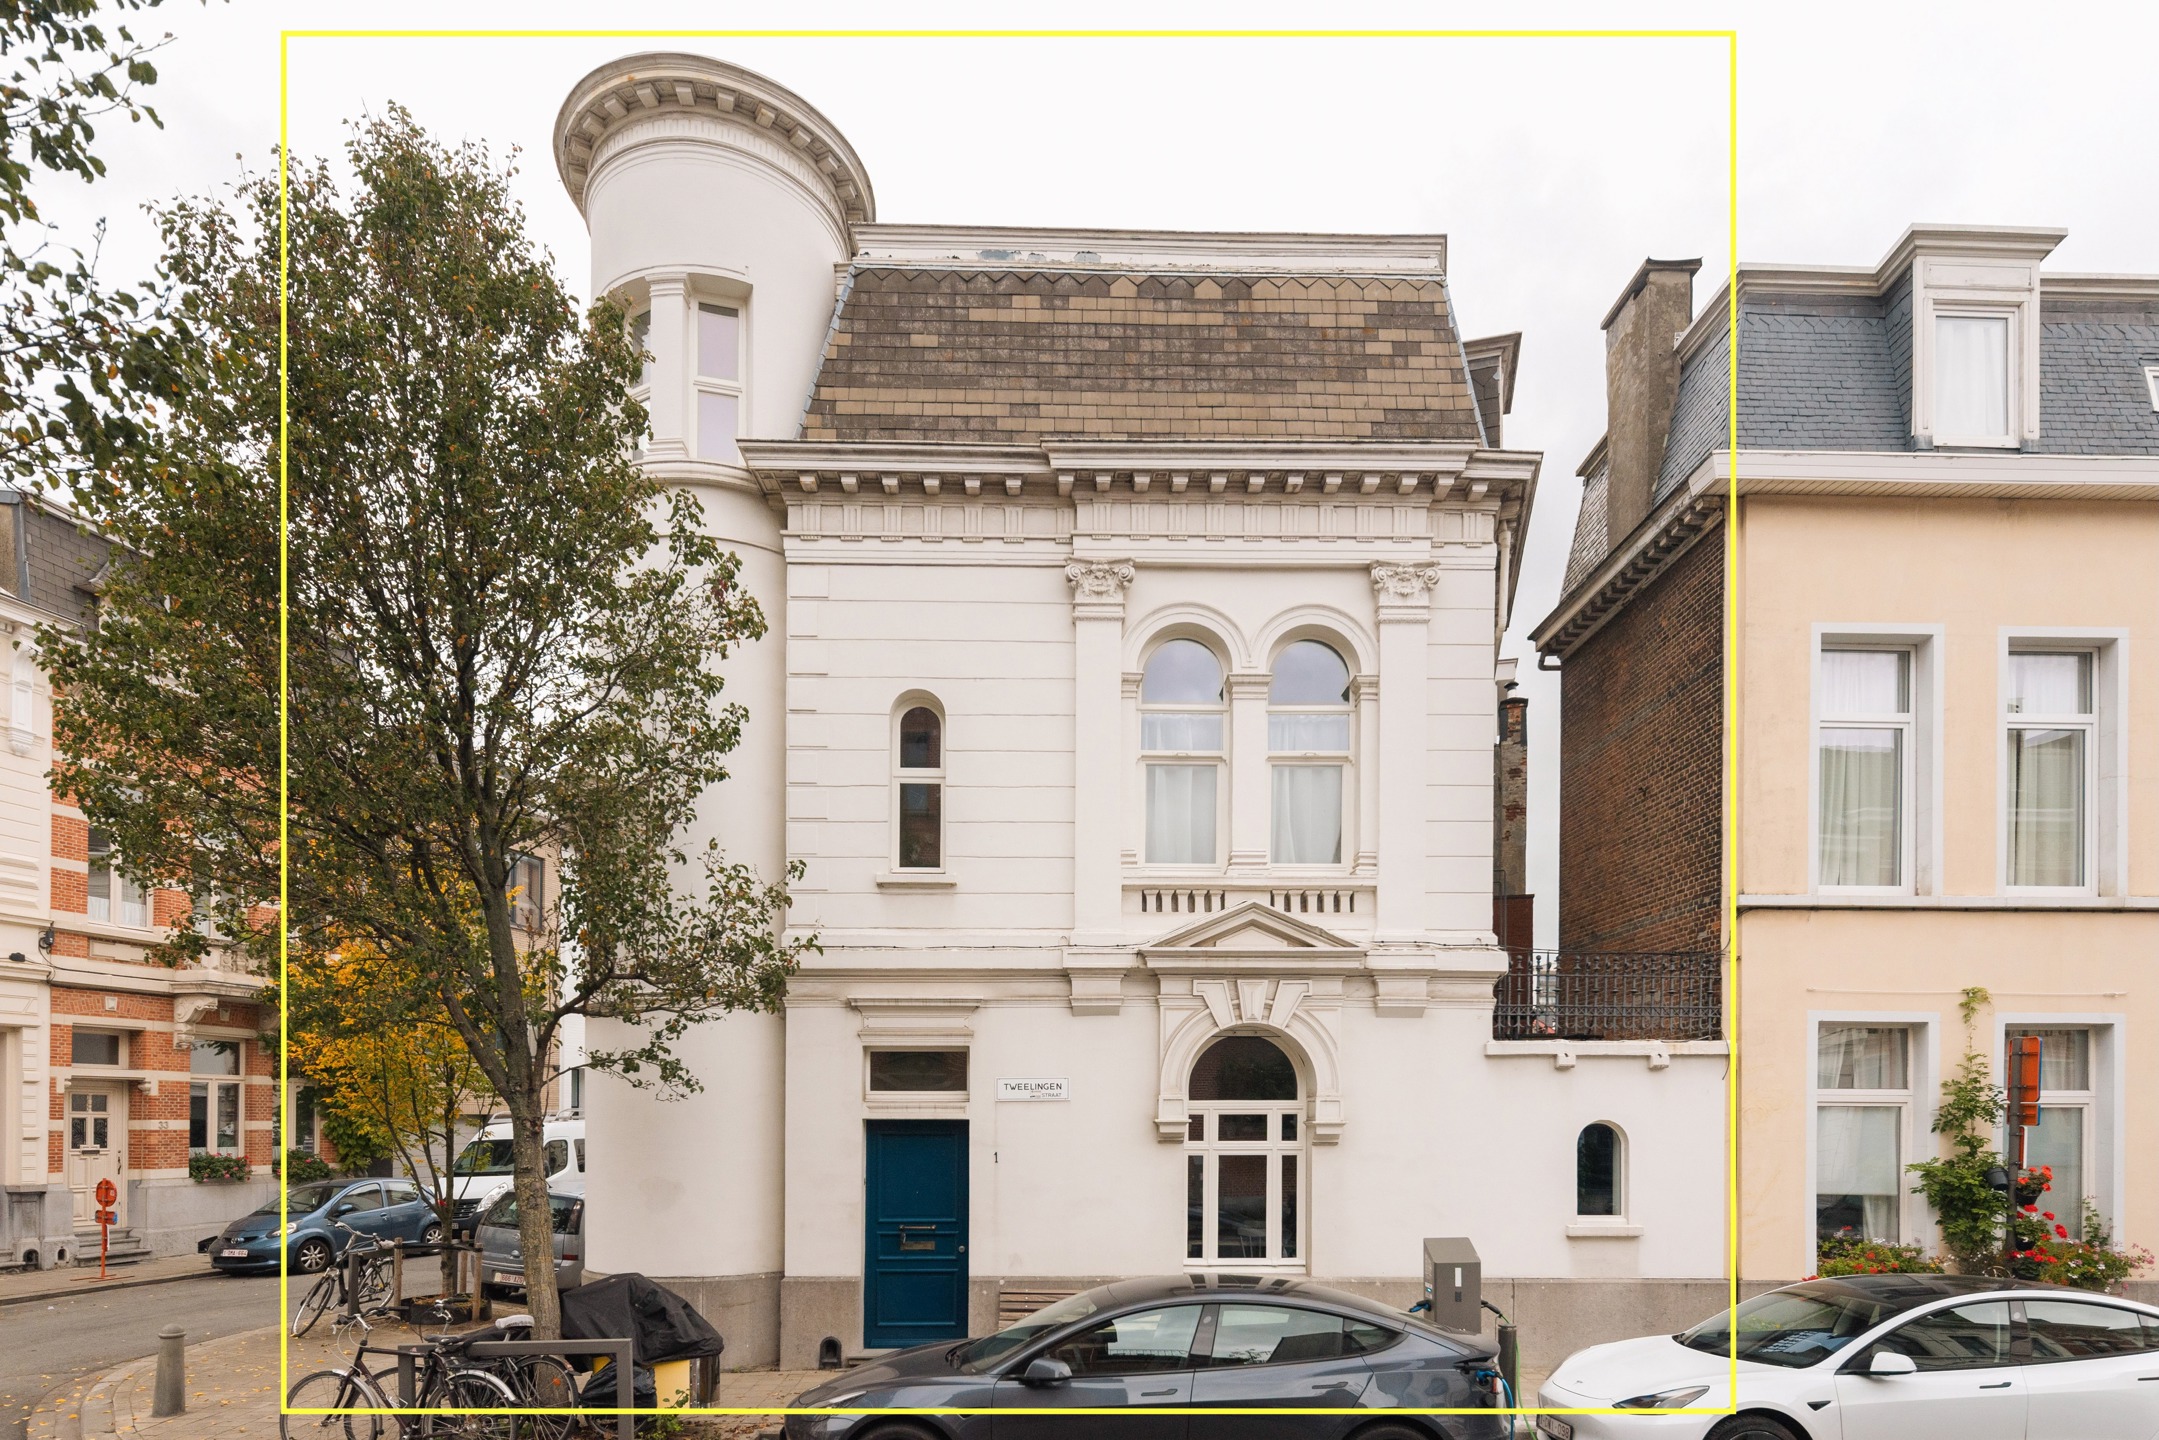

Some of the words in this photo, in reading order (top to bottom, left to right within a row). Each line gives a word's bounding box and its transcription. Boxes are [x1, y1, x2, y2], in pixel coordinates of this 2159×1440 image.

[1004, 1083, 1062, 1091] TWEELINGEN
[158, 1121, 169, 1130] 33
[994, 1152, 998, 1164] 1
